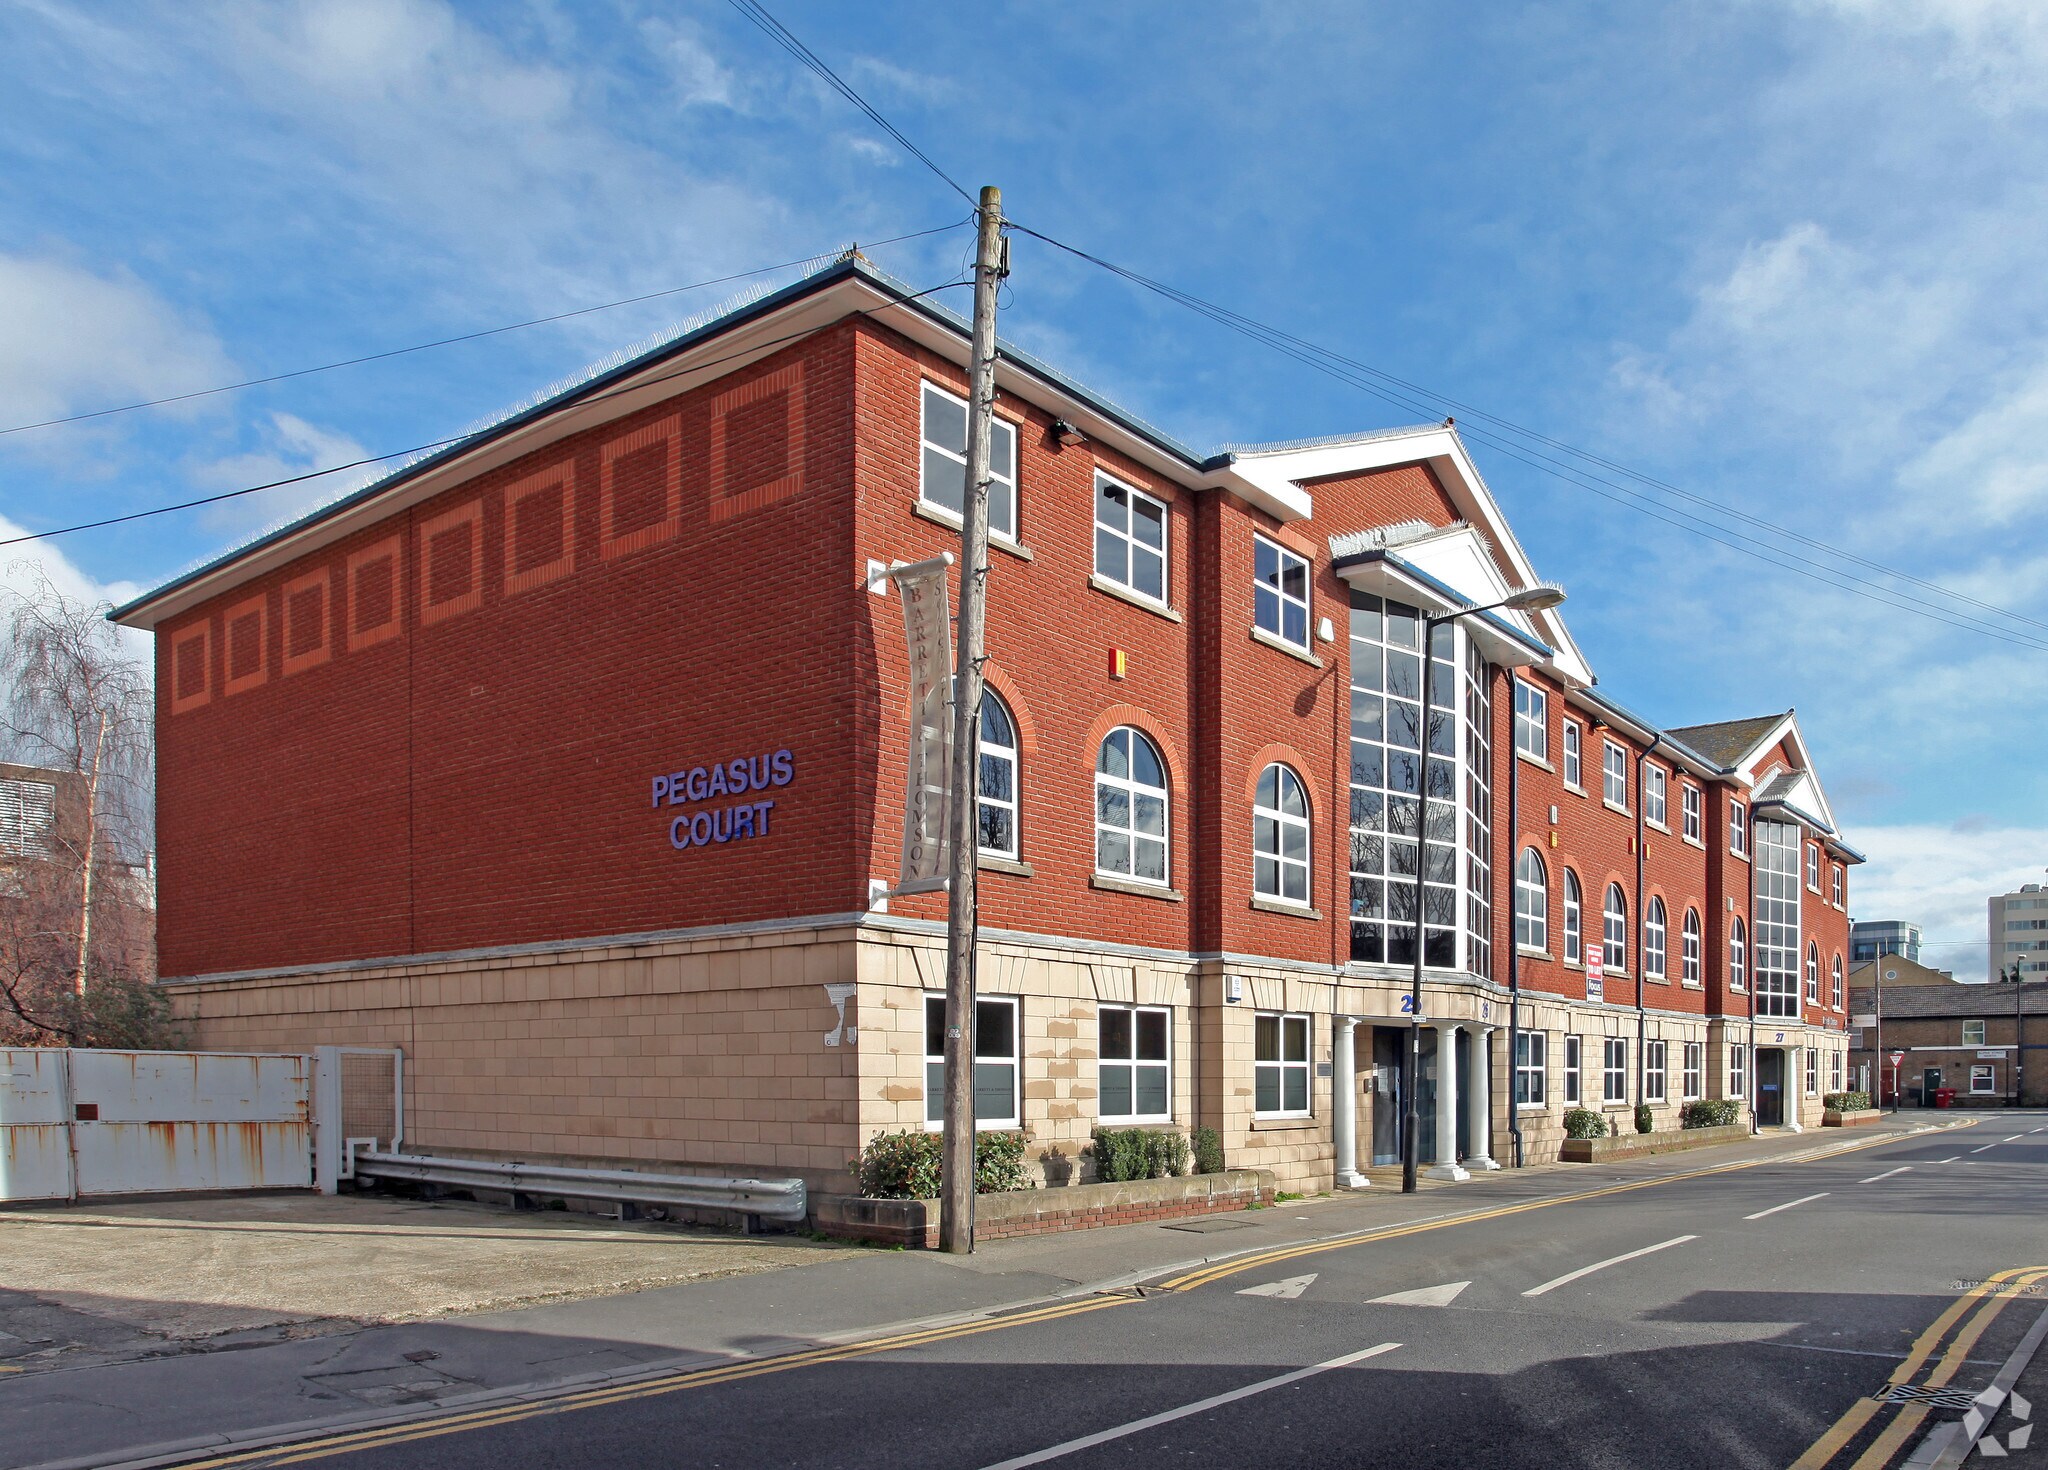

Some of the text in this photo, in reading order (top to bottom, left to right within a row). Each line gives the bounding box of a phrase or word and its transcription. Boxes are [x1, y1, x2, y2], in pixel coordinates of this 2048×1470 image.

[909, 587, 929, 716] BARRETT
[652, 749, 794, 808] PEGASUS
[669, 801, 774, 850] COURT
[909, 752, 928, 880] THOMSON
[1775, 1032, 1785, 1042] 27
